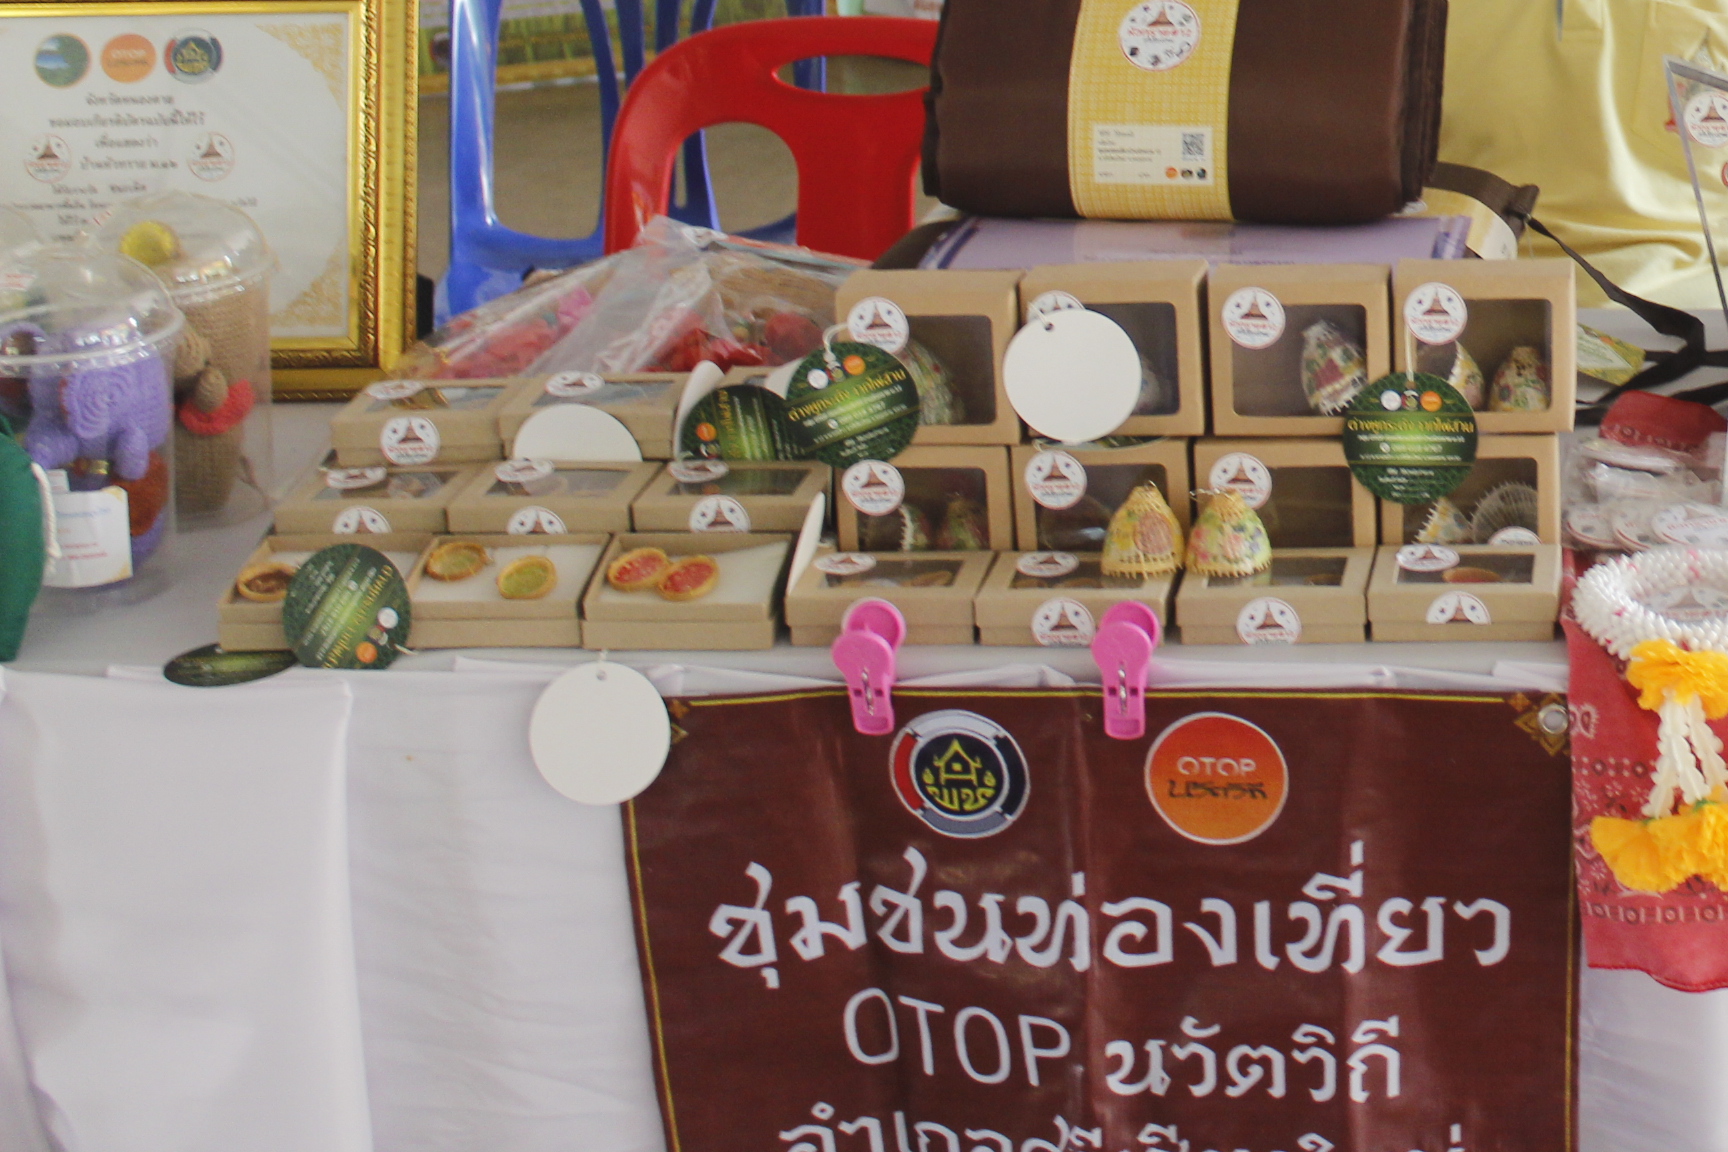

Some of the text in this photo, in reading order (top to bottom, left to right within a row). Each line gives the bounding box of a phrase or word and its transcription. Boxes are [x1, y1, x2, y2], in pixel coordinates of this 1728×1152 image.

[1178, 755, 1257, 777] OTOP
[708, 840, 1512, 988] ชุมชนท่องเที่ยว
[843, 987, 1402, 1102] OTOP นวัตวิถี
